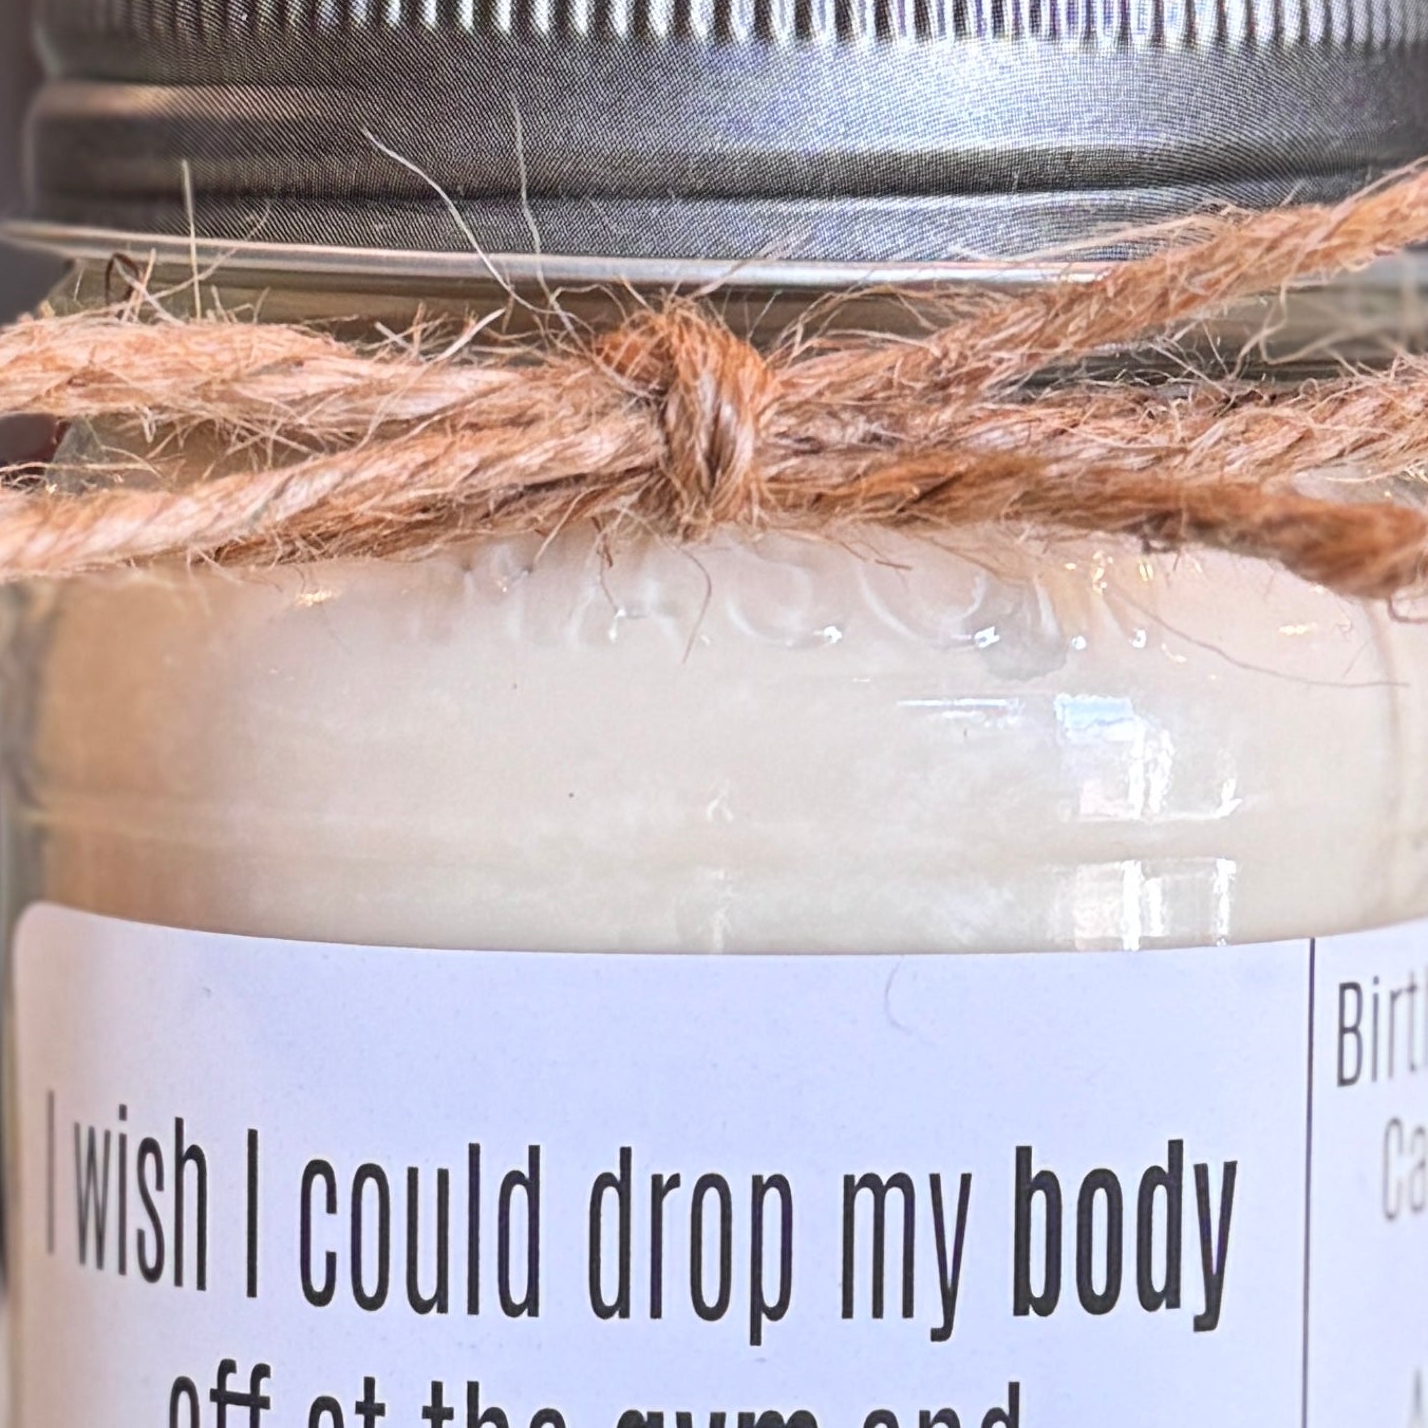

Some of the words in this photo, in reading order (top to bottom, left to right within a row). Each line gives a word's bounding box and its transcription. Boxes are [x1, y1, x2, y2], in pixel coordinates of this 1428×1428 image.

[45, 1089, 56, 1257] I
[73, 1103, 208, 1292] wish
[246, 1128, 259, 1299] I
[299, 1142, 541, 1318] could
[588, 1146, 793, 1347] drop
[841, 1171, 973, 1343] my
[1012, 1138, 1238, 1333] body
